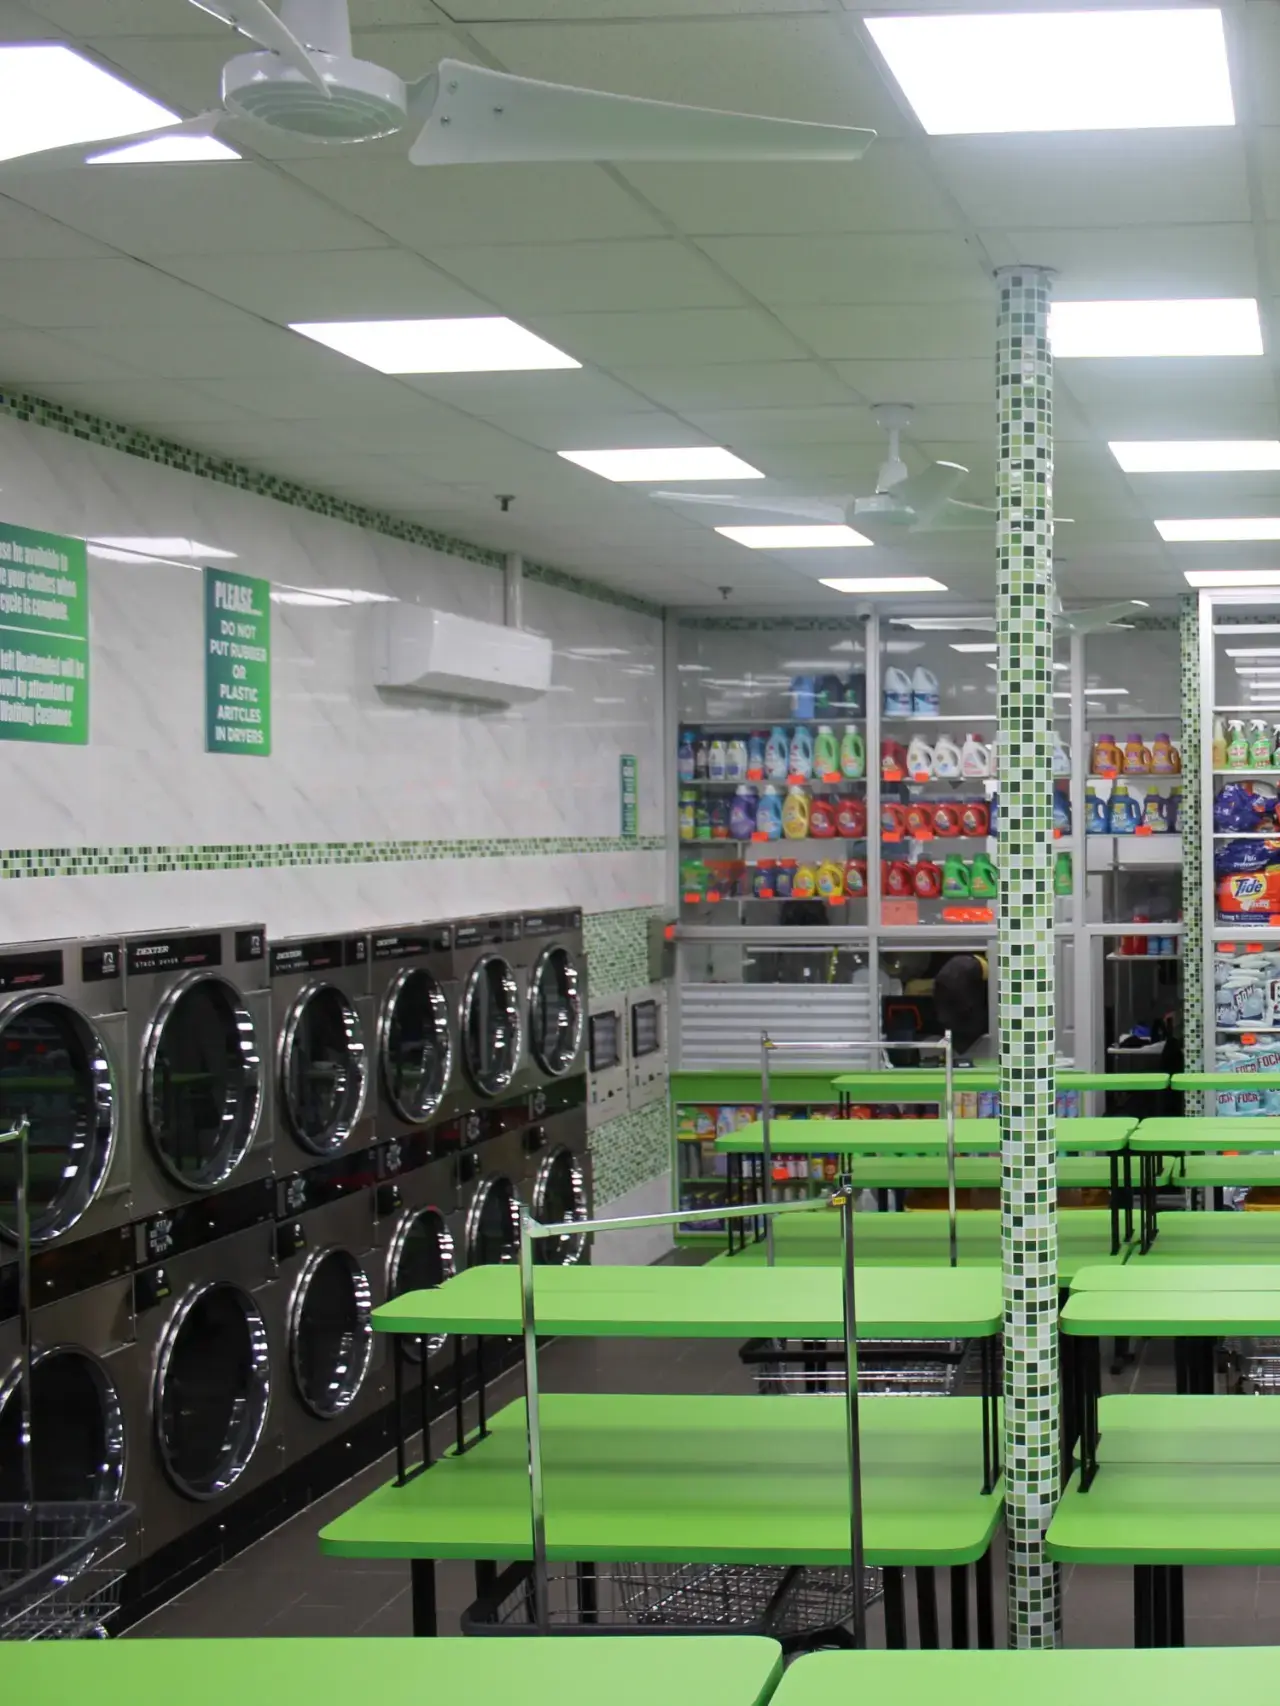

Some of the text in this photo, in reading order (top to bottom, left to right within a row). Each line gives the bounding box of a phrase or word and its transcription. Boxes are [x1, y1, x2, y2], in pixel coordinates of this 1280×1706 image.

[221, 620, 256, 640] DO NOT
[210, 638, 267, 662] PUT RUBBER
[232, 664, 247, 680] OR
[220, 684, 258, 702] PLASTIC
[215, 726, 265, 744] IN DRYERS
[1235, 877, 1263, 897] Tide
[136, 945, 170, 956] DEXTER
